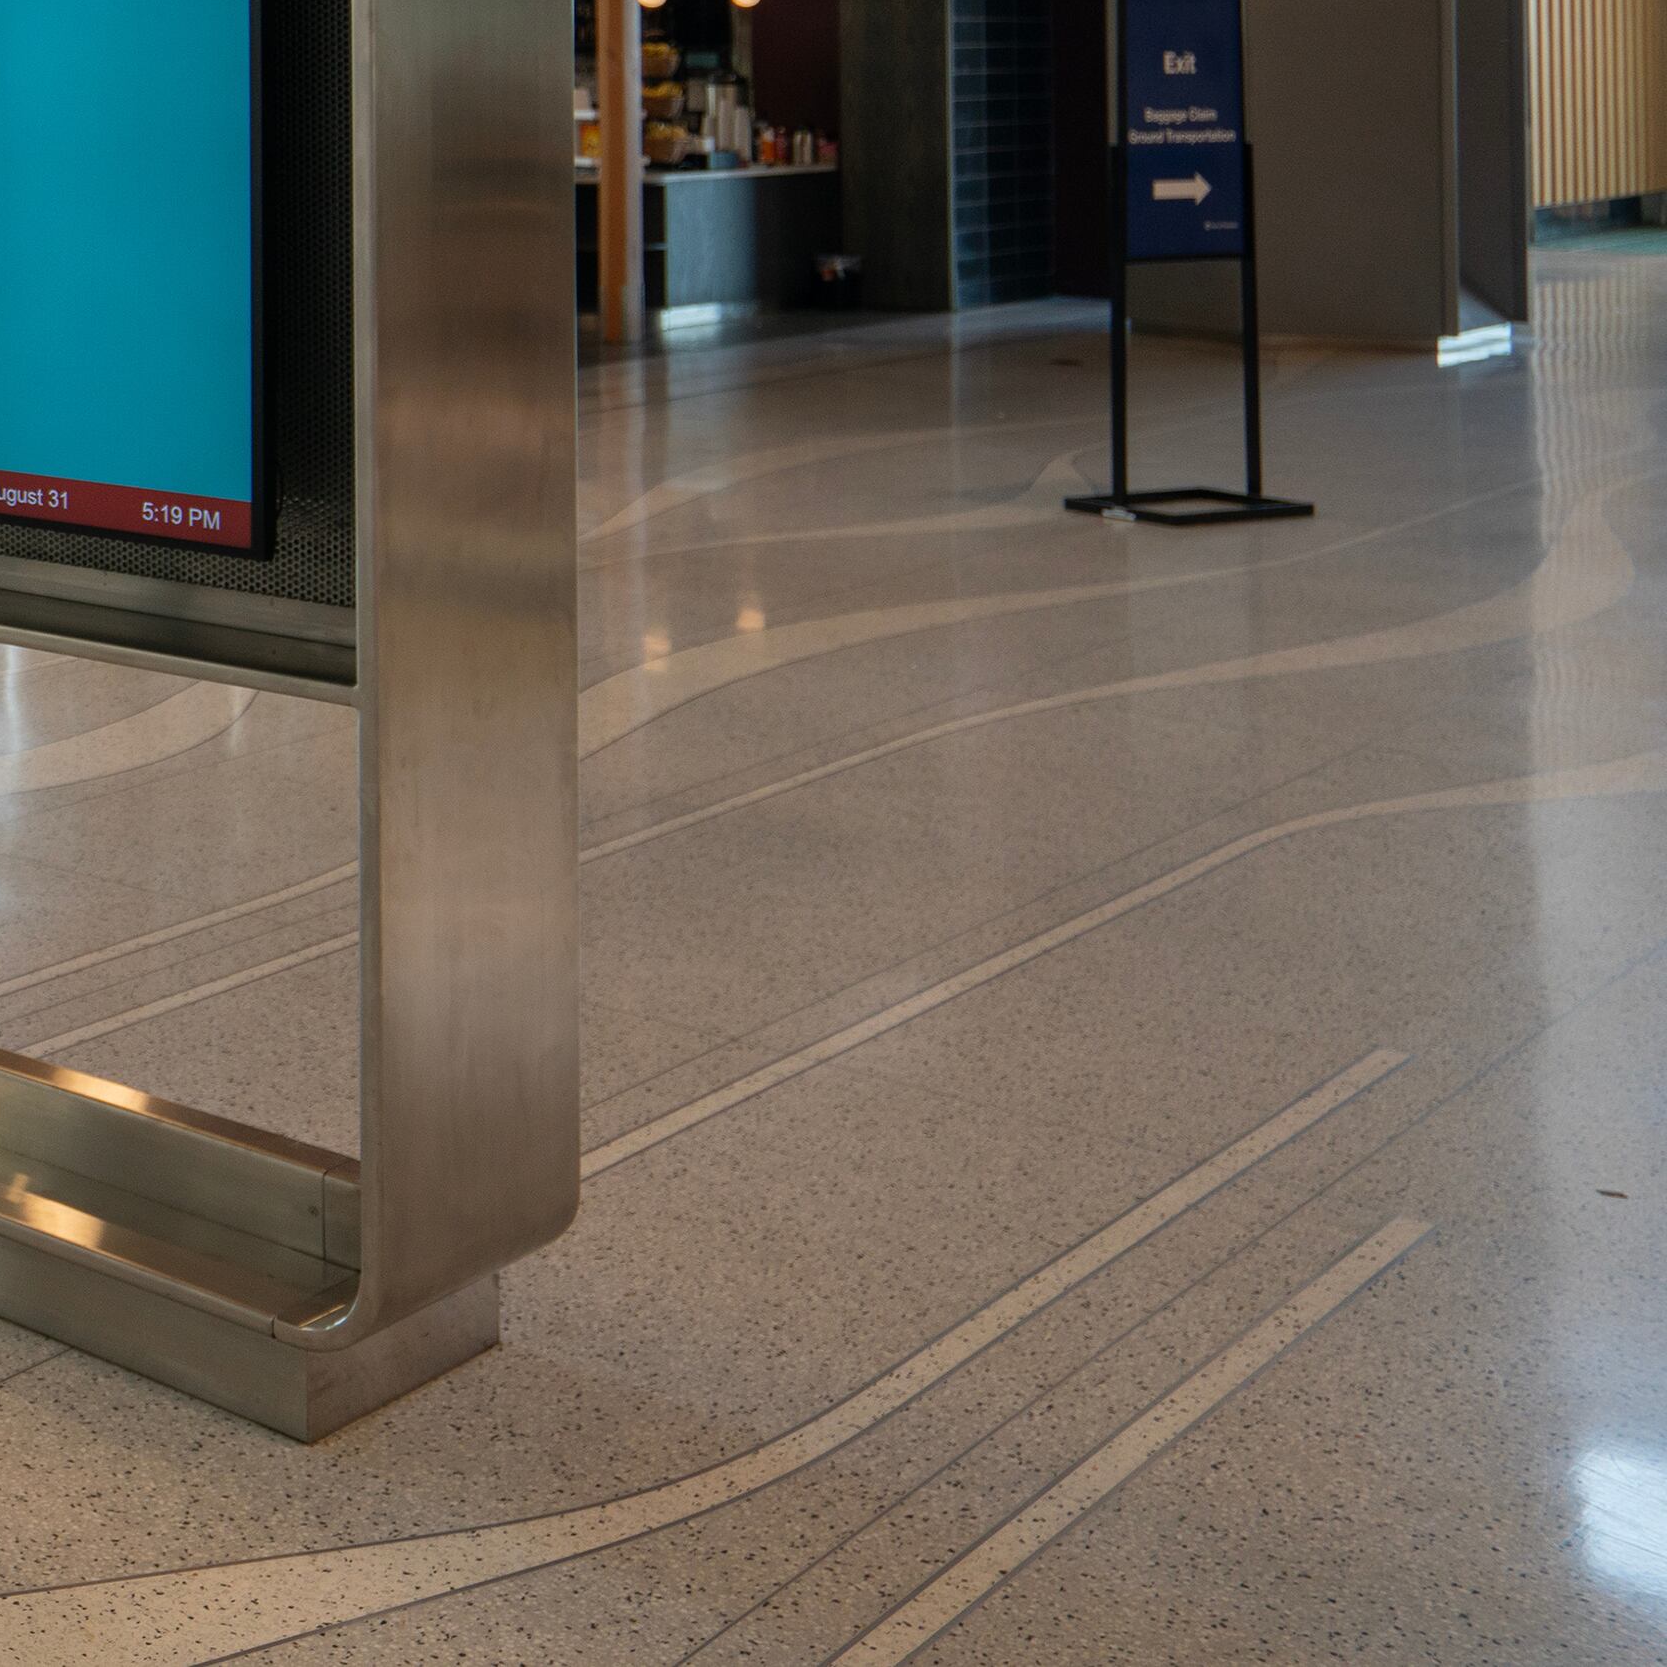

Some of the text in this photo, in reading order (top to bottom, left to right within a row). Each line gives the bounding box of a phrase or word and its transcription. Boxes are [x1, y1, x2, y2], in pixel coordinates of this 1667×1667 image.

[1163, 50, 1196, 74] Exit
[48, 489, 68, 509] 31
[142, 501, 183, 525] 5:19
[189, 507, 220, 530] PM
